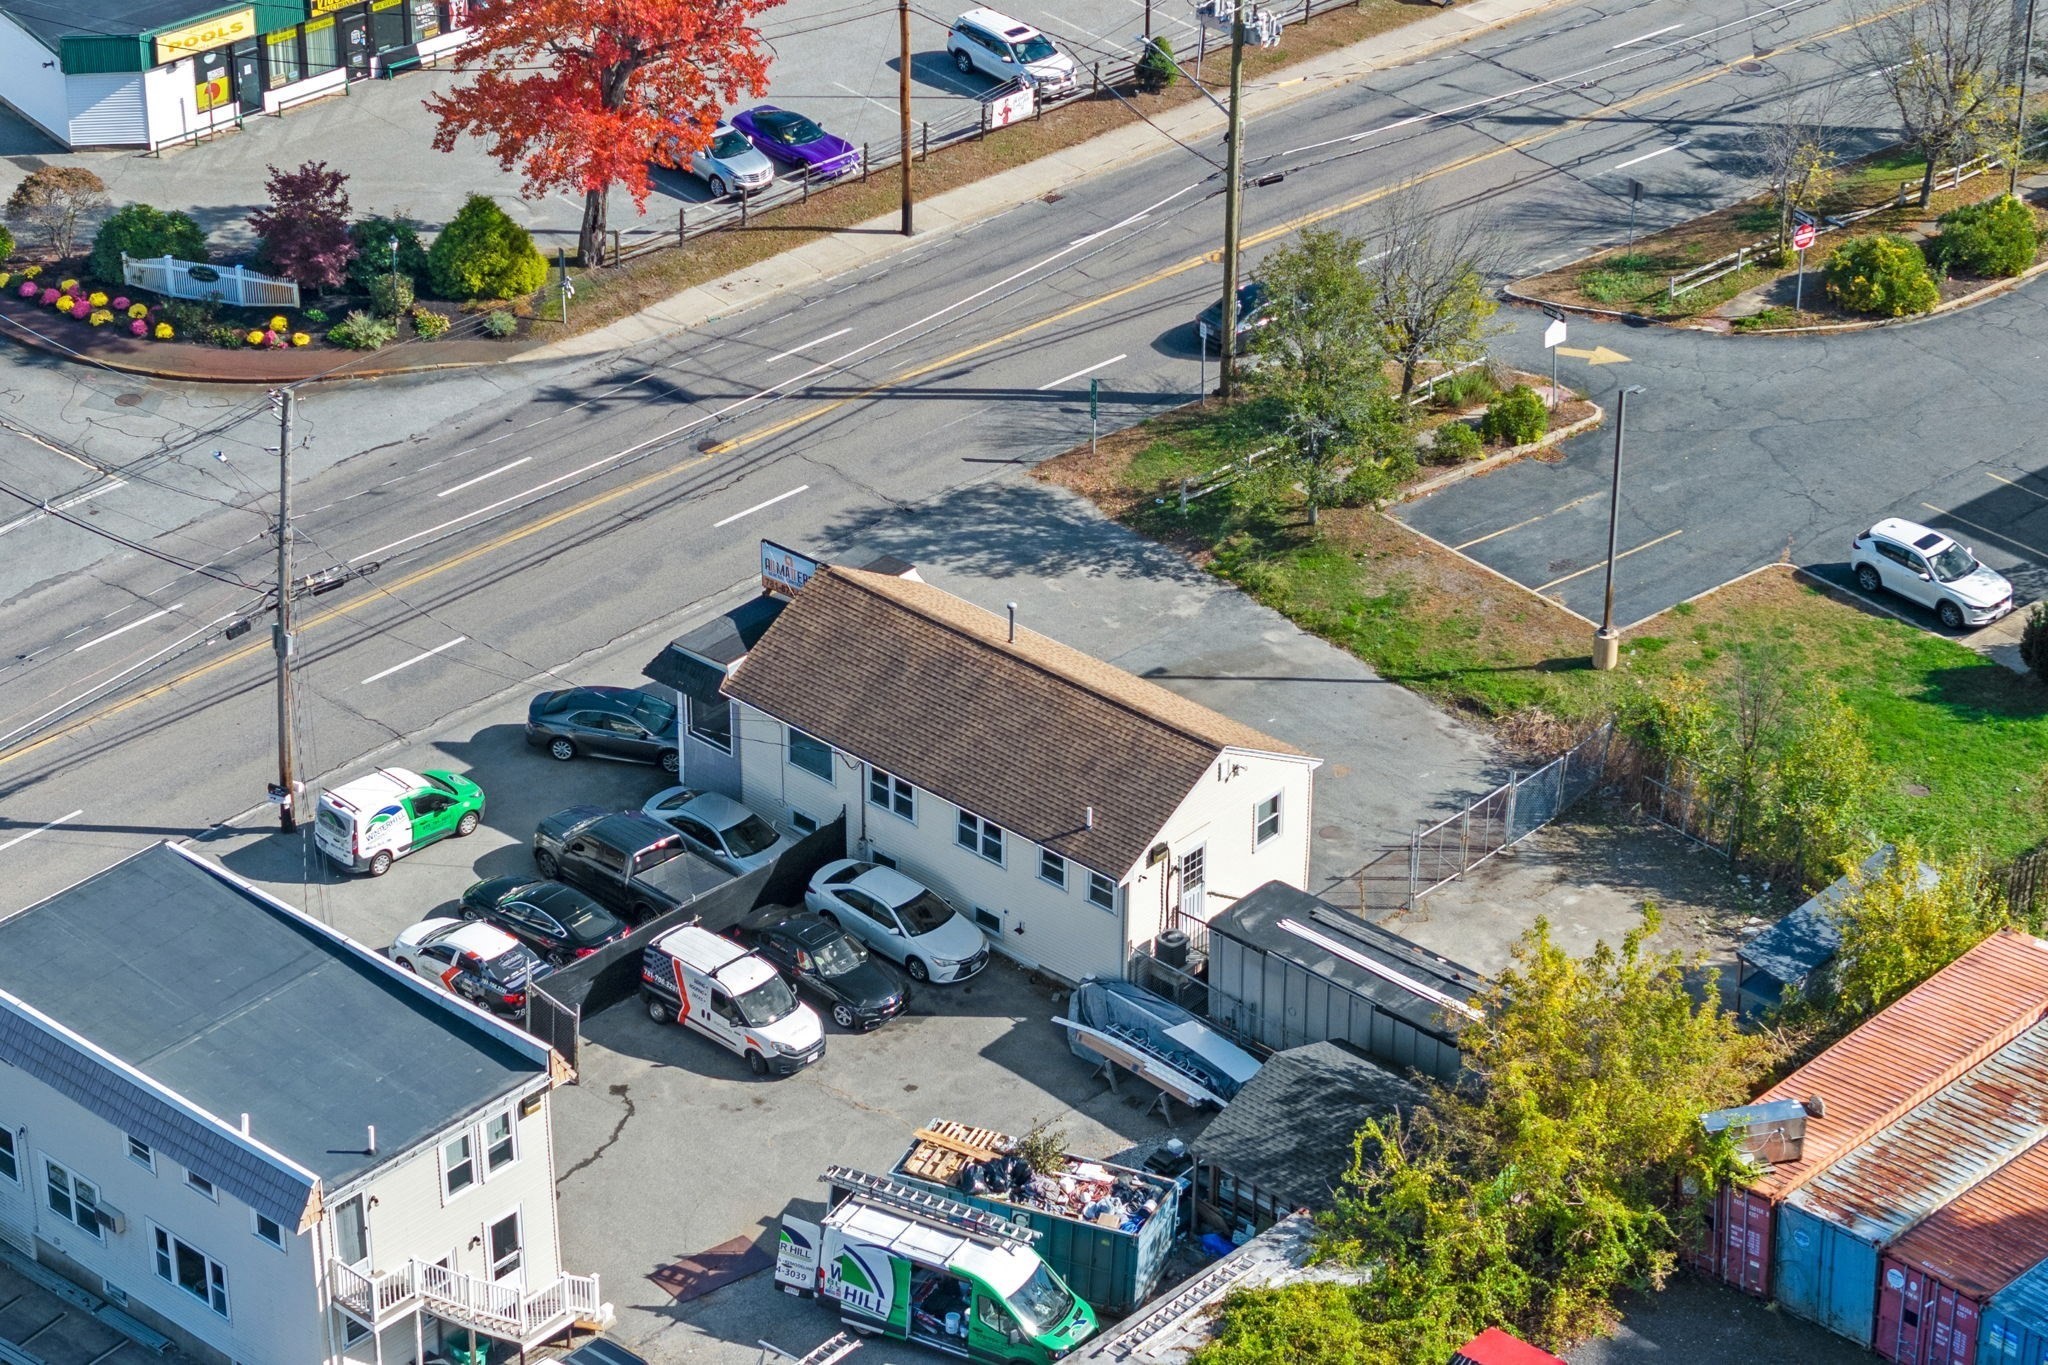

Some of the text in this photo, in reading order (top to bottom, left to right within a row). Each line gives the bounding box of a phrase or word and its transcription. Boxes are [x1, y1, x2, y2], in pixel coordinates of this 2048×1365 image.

[168, 21, 244, 53] POOLS
[789, 1243, 812, 1260] HILL
[843, 1286, 886, 1316] HILL
